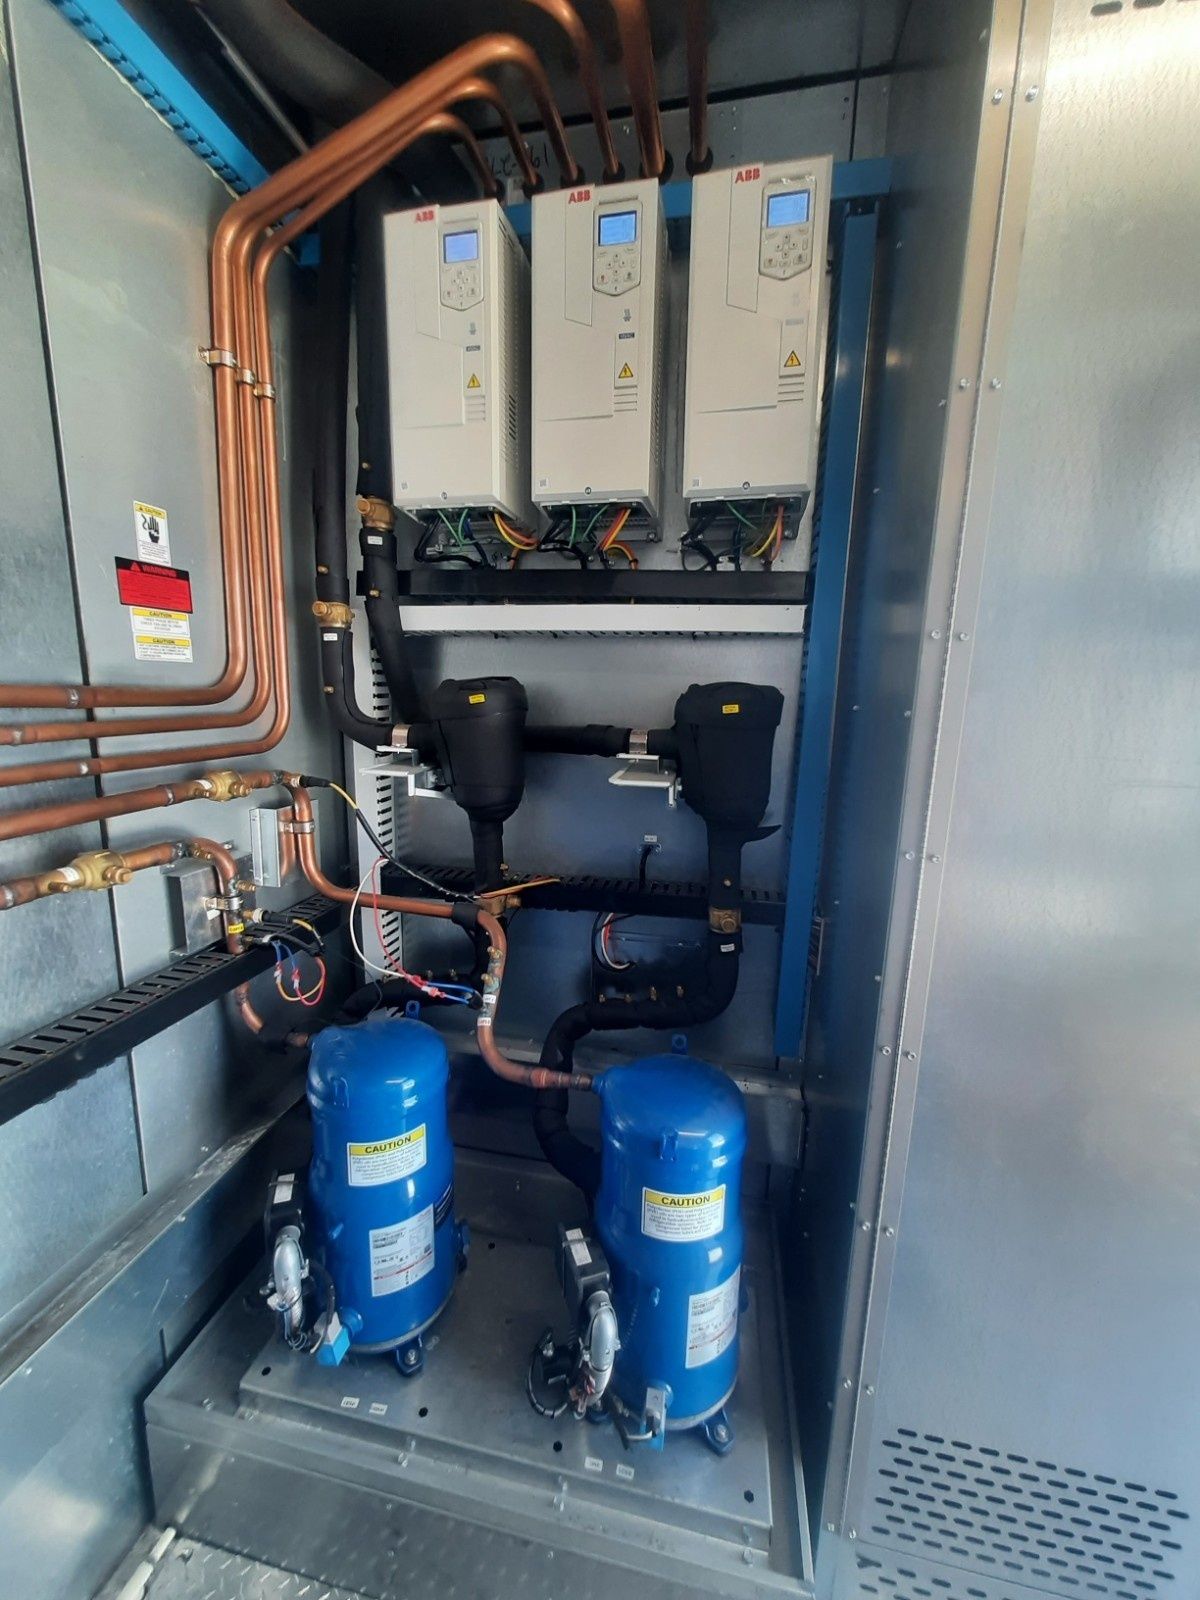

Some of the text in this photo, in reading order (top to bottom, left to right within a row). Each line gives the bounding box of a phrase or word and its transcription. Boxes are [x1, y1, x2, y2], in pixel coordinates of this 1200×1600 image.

[735, 167, 761, 183] ABB
[568, 189, 592, 204] ABB
[414, 210, 435, 224] ABB
[365, 1135, 412, 1154] CAUTION
[661, 1195, 711, 1207] CAUTION
